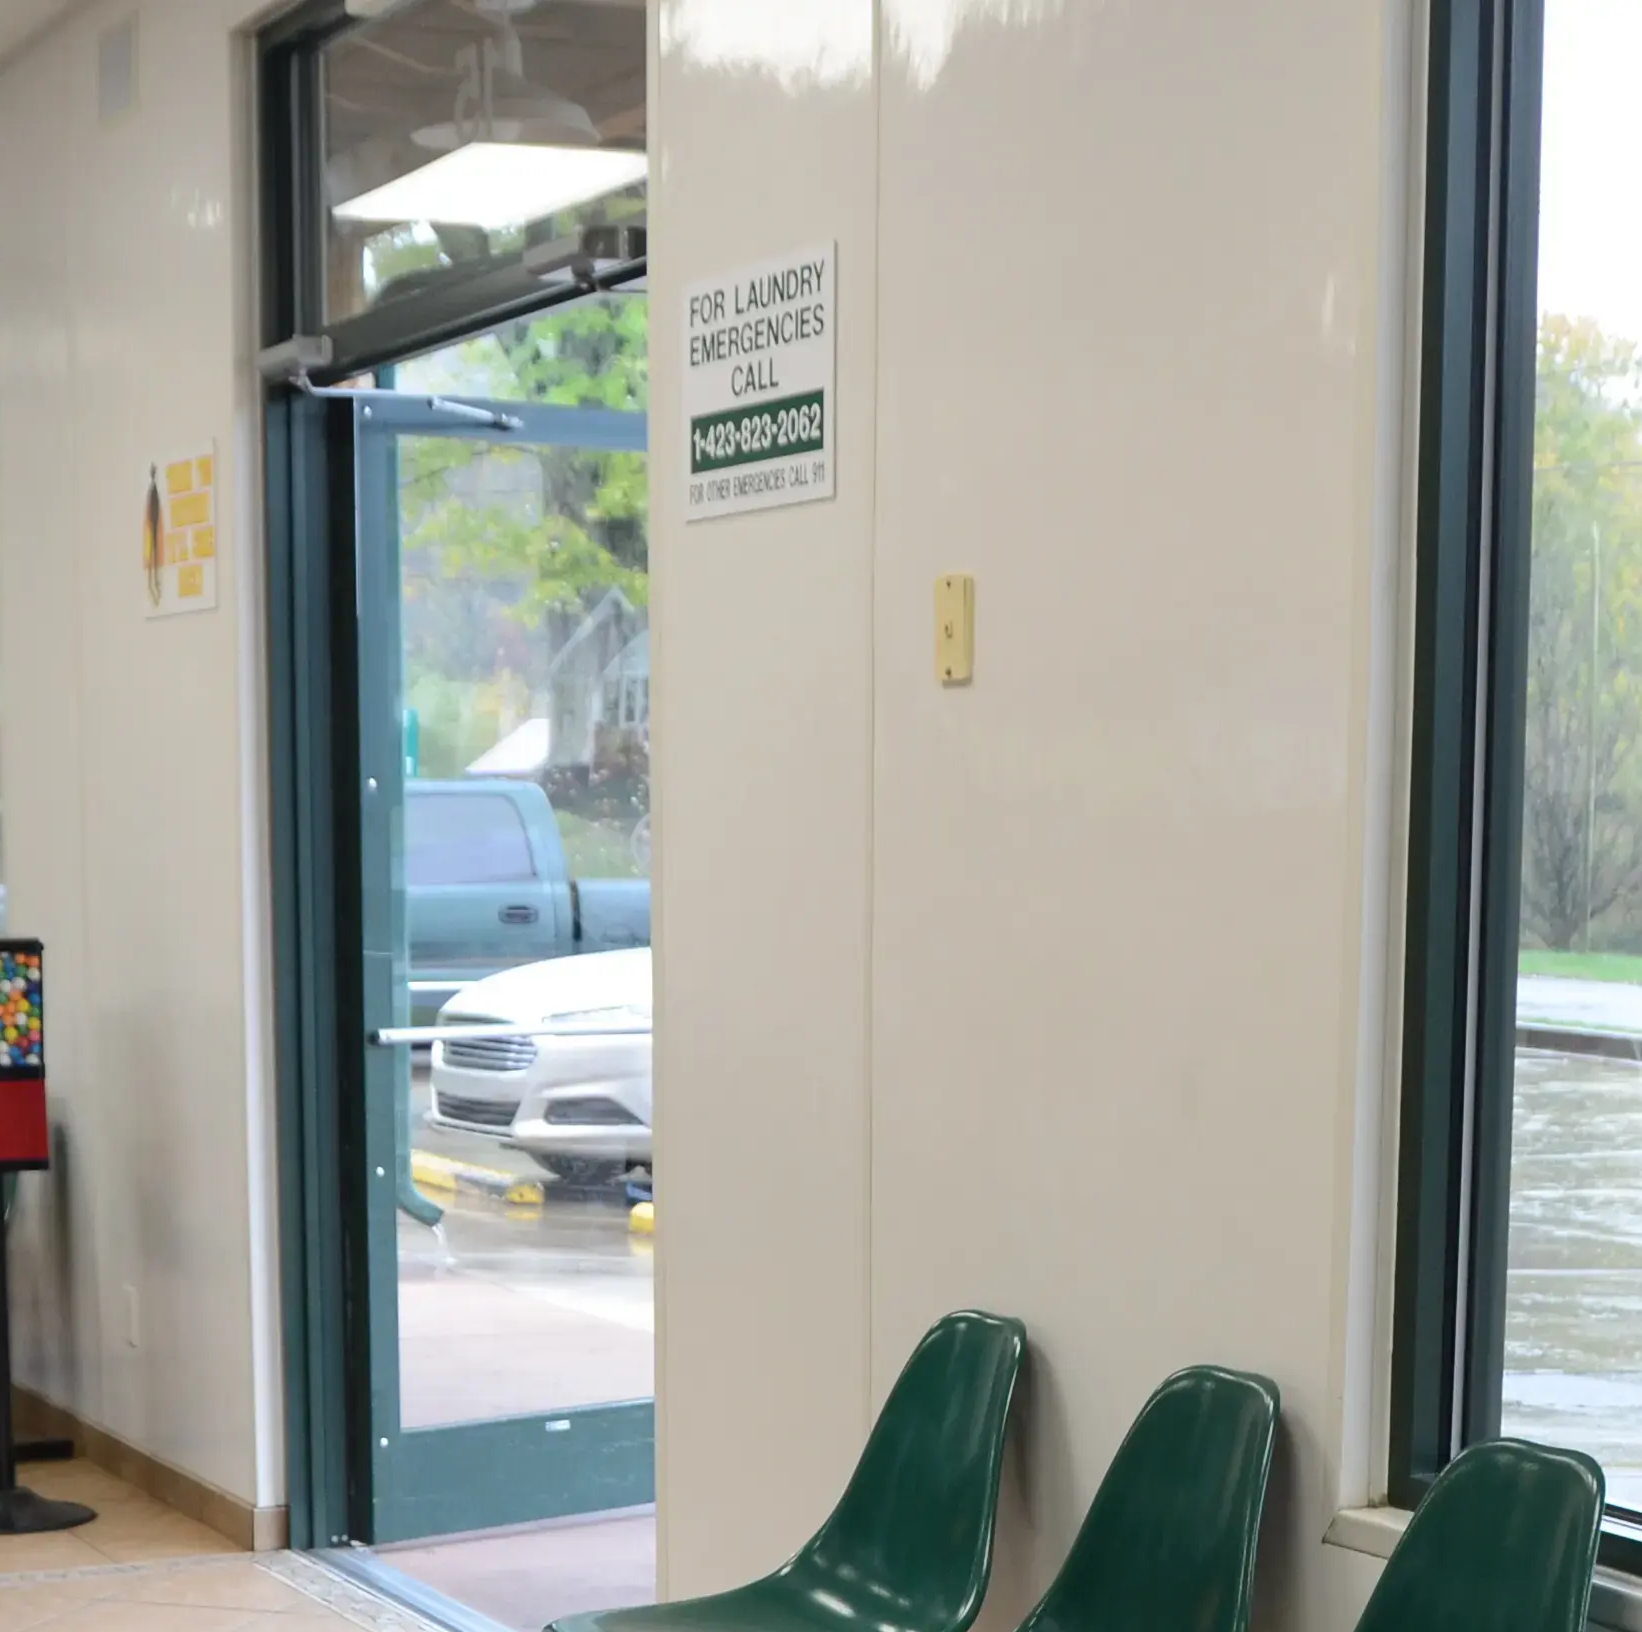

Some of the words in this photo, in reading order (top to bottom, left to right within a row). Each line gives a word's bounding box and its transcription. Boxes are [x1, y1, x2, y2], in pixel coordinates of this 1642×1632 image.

[690, 289, 725, 328] FOR
[735, 259, 824, 315] LAUNDRY
[690, 304, 824, 367] EMERGENCIES
[731, 357, 779, 396] CALL
[690, 482, 704, 505] FOR
[706, 478, 730, 502] OTHER
[733, 467, 785, 497] EMERGENCIES
[789, 464, 808, 487] CALL
[812, 460, 824, 483] 911
